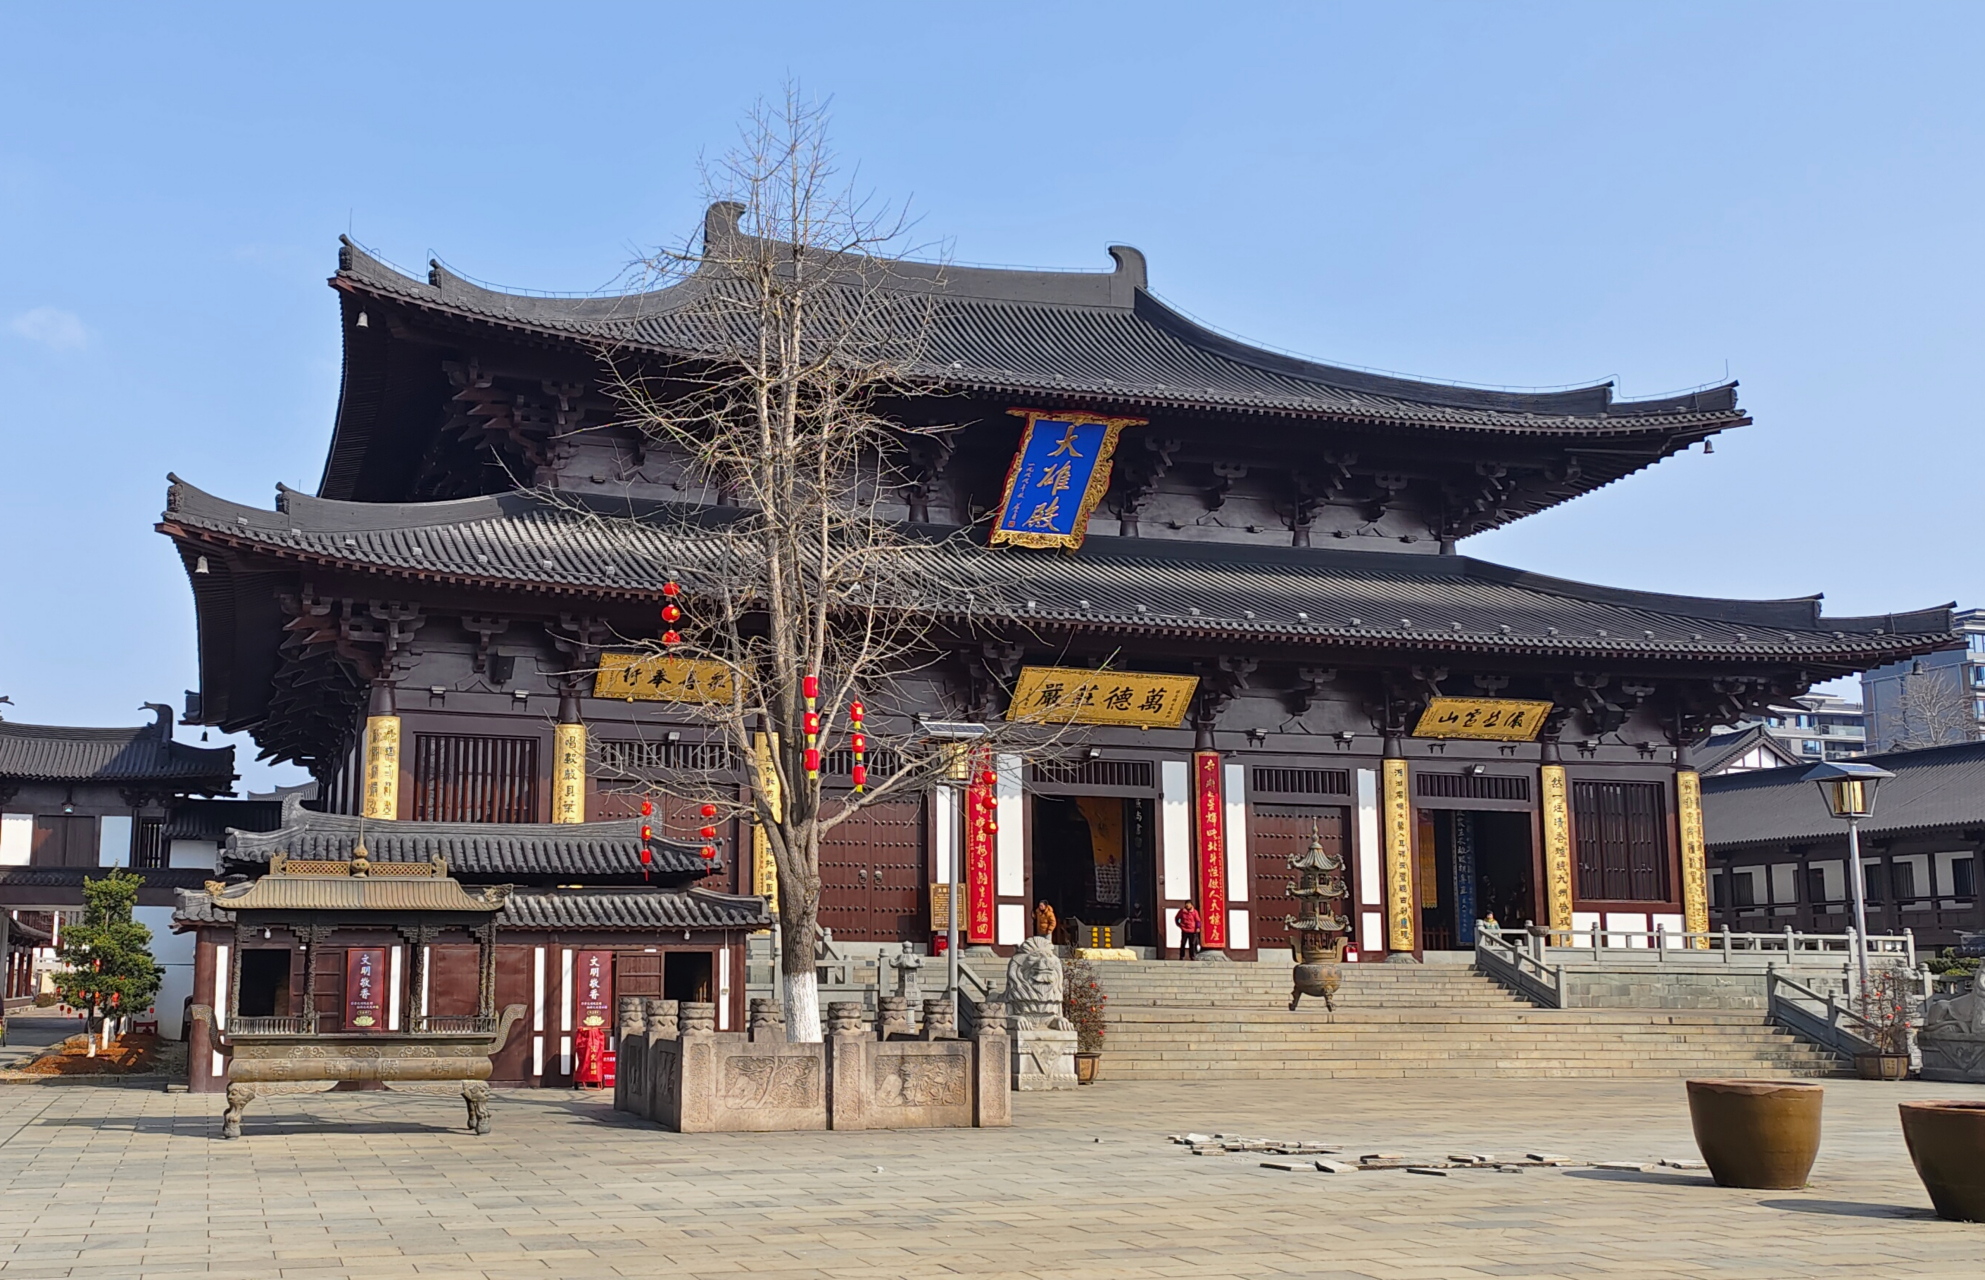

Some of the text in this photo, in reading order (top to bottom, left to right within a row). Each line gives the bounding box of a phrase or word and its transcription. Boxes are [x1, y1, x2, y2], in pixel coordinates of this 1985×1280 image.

[1022, 424, 1083, 532] 大雄殿
[359, 953, 372, 1000] 文明敬香
[588, 955, 601, 1000] 文明敬香
